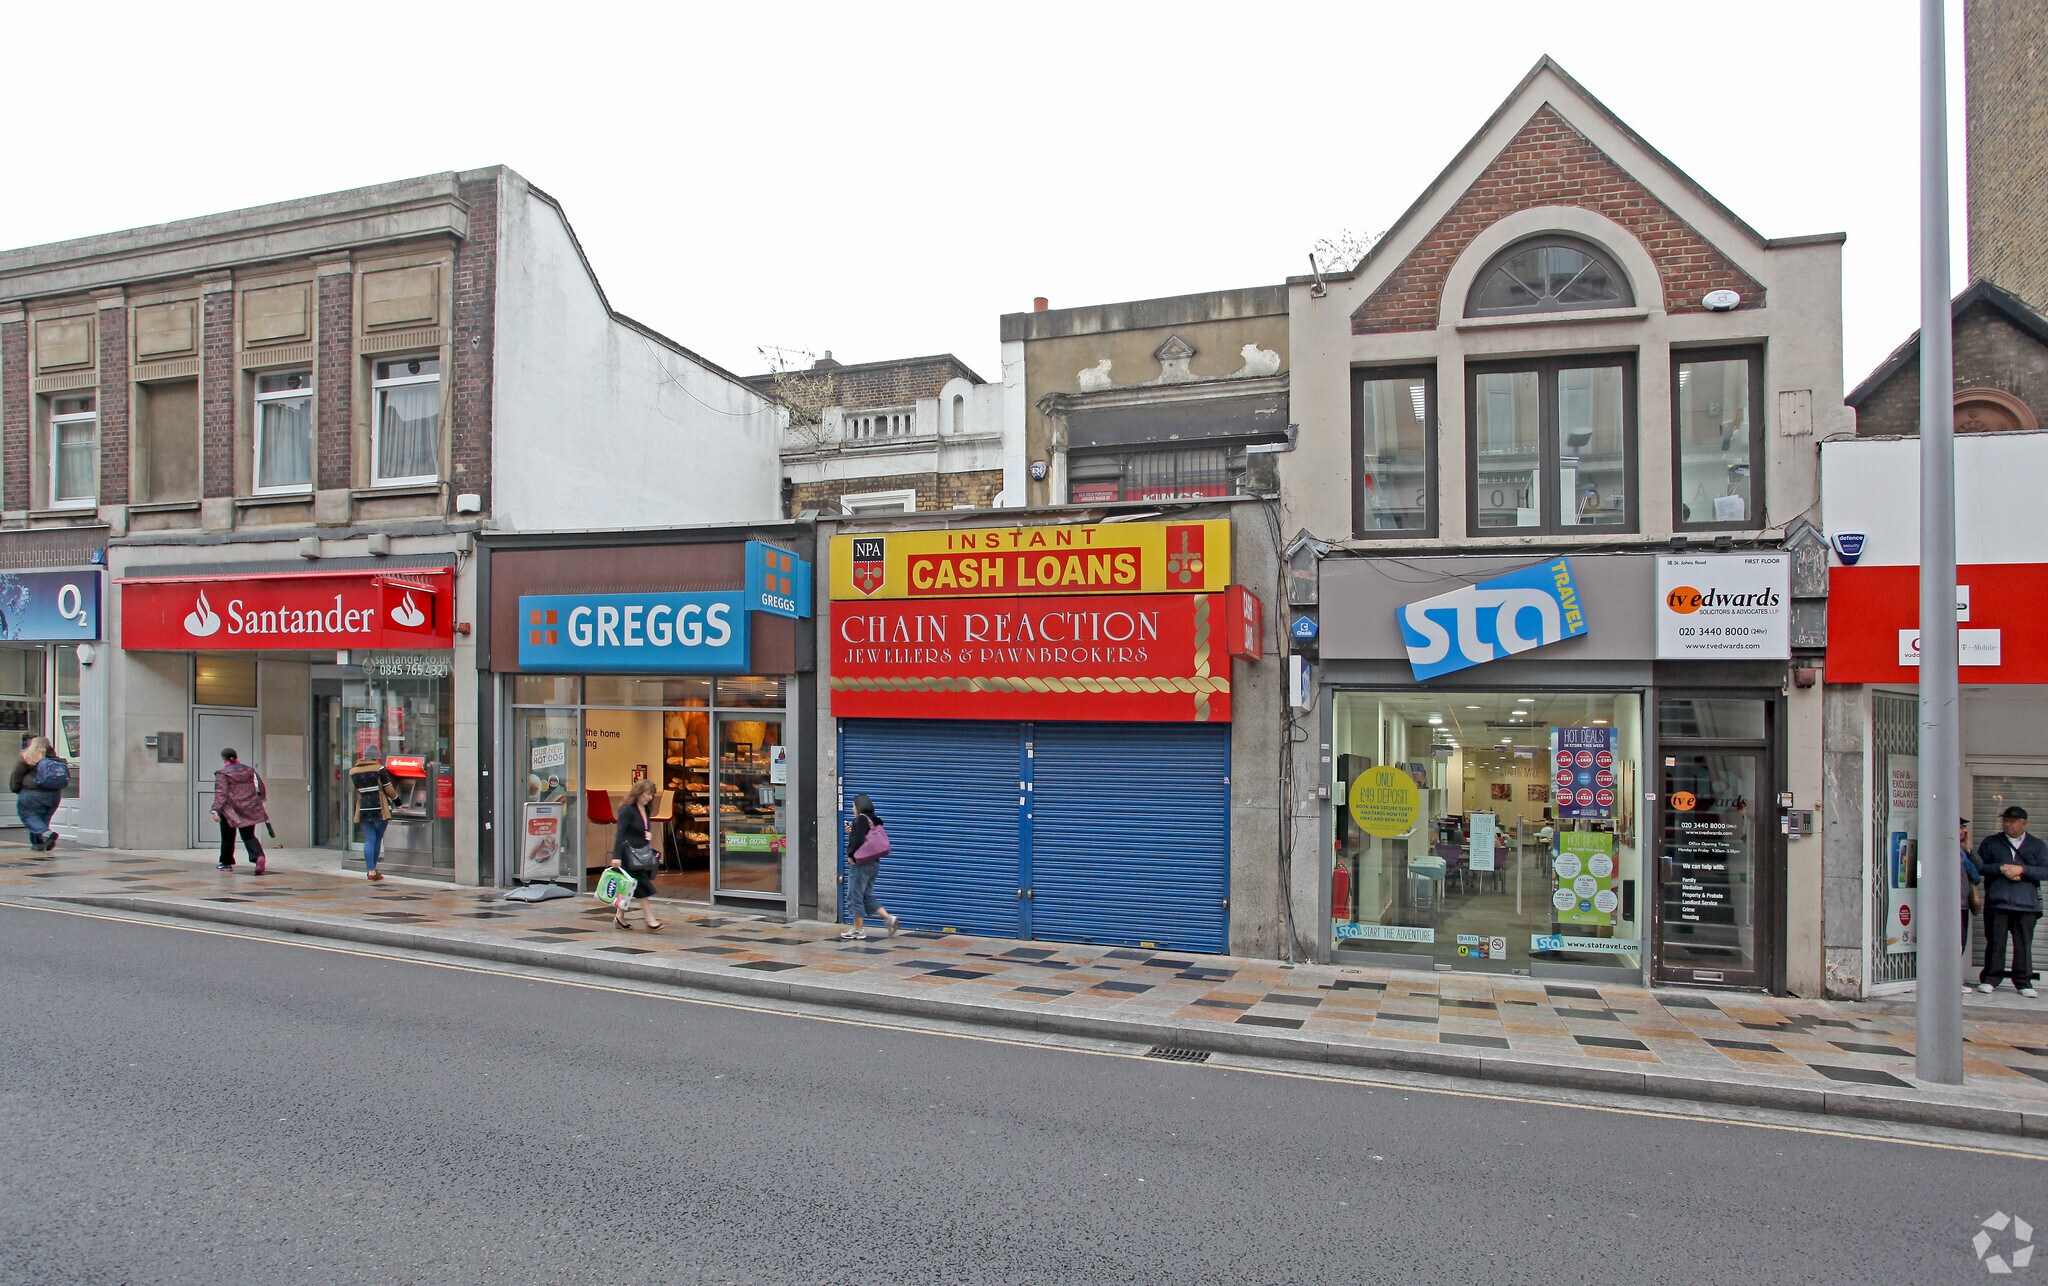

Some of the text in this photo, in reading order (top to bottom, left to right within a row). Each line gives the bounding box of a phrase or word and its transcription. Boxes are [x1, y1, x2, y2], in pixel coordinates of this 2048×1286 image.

[948, 529, 1096, 550] INSTANT
[855, 542, 882, 558] NPA
[912, 553, 1136, 590] CASH LOANS
[761, 593, 795, 612] GREGGS
[1551, 560, 1584, 634] TRAVEL
[1690, 587, 1780, 607] edwards
[227, 594, 374, 635] Santander
[568, 602, 732, 648] GREGGS
[841, 611, 1160, 644] CHAIN REACTION
[1404, 584, 1561, 665] sta
[1679, 627, 1696, 636] 020
[1699, 627, 1722, 636] 3440
[1724, 627, 1749, 636] 8000
[375, 654, 452, 665] santander.co.uk
[844, 646, 1148, 663] JEWELLERS & PAWNBROKERS
[380, 664, 448, 676] 0845 765 4321
[600, 728, 620, 738] home
[1564, 729, 1604, 743] HOT DEALS
[533, 745, 563, 757] OUR NEW
[571, 739, 597, 750] baing
[533, 753, 563, 765] HOT DOG
[1375, 771, 1395, 787] ONLY
[1891, 770, 1910, 779] NEW &
[1360, 787, 1408, 804] £49 DEPOSIT
[1892, 790, 1913, 799] GALAXY
[1892, 799, 1919, 809] MINI GOLD
[1567, 834, 1605, 848] HOT DEALS
[1701, 863, 1712, 871] help
[1338, 925, 1358, 937] sta
[1363, 926, 1431, 941] START THE ADVENTURE
[1539, 936, 1560, 949] sta
[1567, 942, 1638, 950] www.statravel.com
